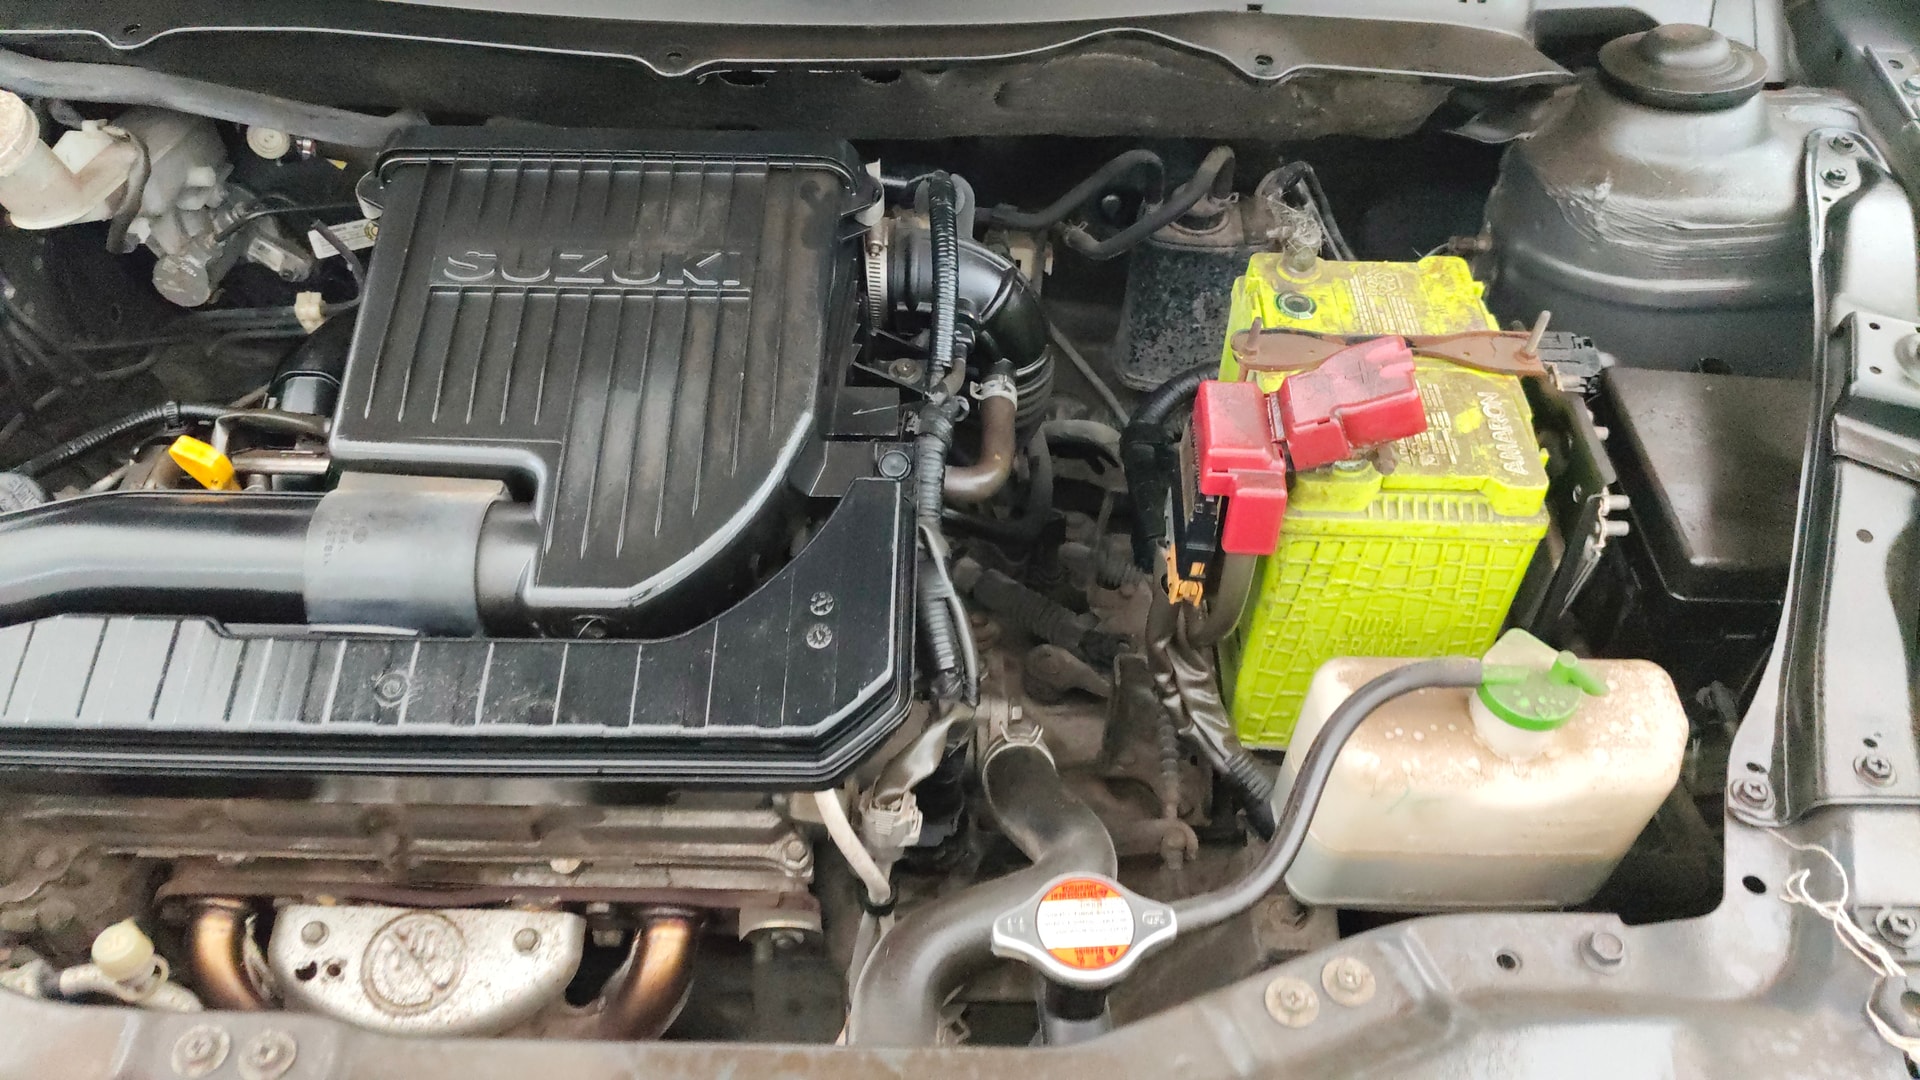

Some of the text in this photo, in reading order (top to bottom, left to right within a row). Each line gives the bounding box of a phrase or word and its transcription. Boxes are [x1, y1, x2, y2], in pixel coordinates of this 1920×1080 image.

[443, 250, 741, 285] SUZUKI
[1477, 391, 1530, 477] AMARON
[1347, 615, 1407, 636] DURA
